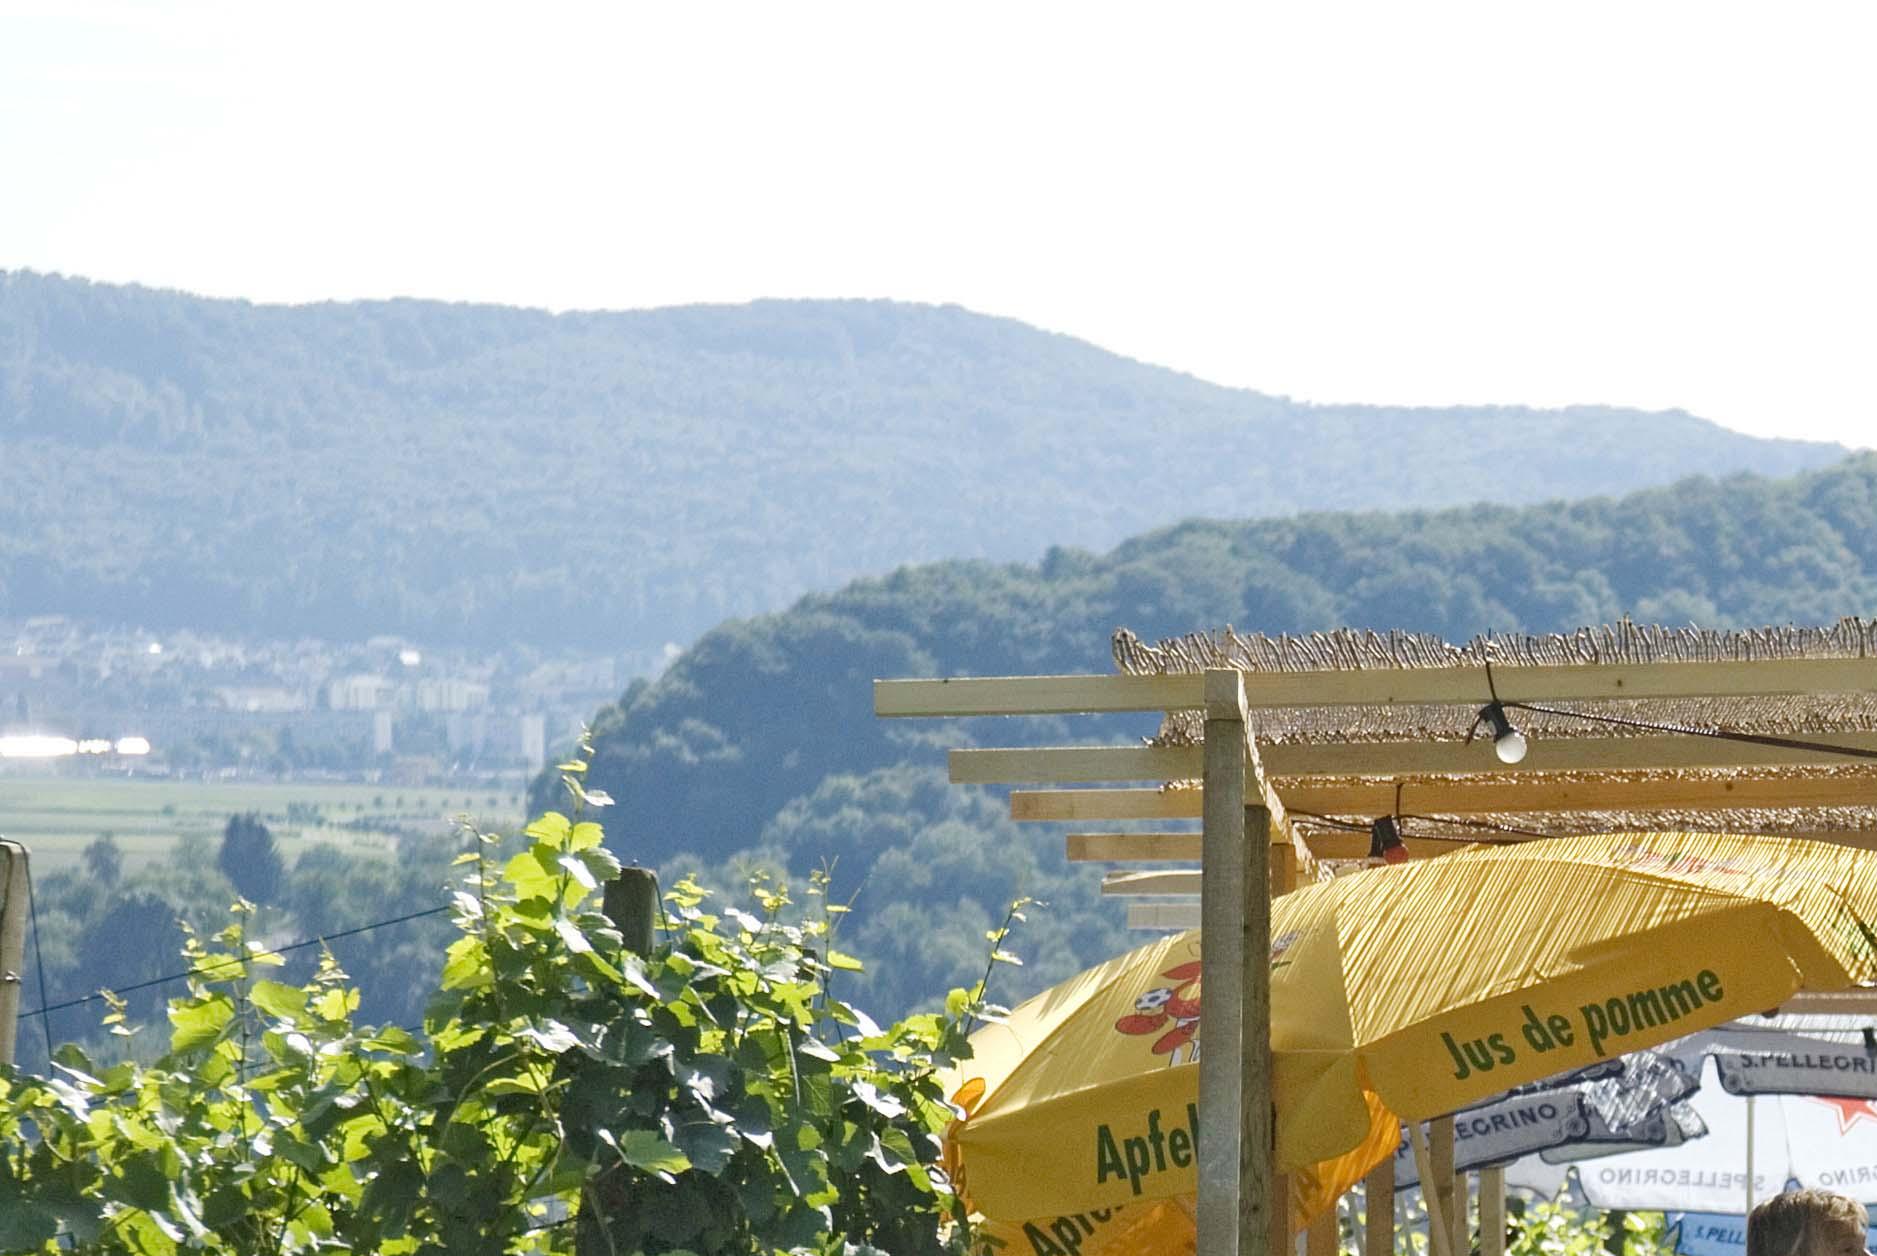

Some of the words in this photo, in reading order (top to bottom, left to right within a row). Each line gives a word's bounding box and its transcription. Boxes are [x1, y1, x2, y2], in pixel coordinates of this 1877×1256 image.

[1440, 1031, 1517, 1081] Jus
[1520, 1004, 1574, 1053] de
[1582, 967, 1725, 1057] pomme
